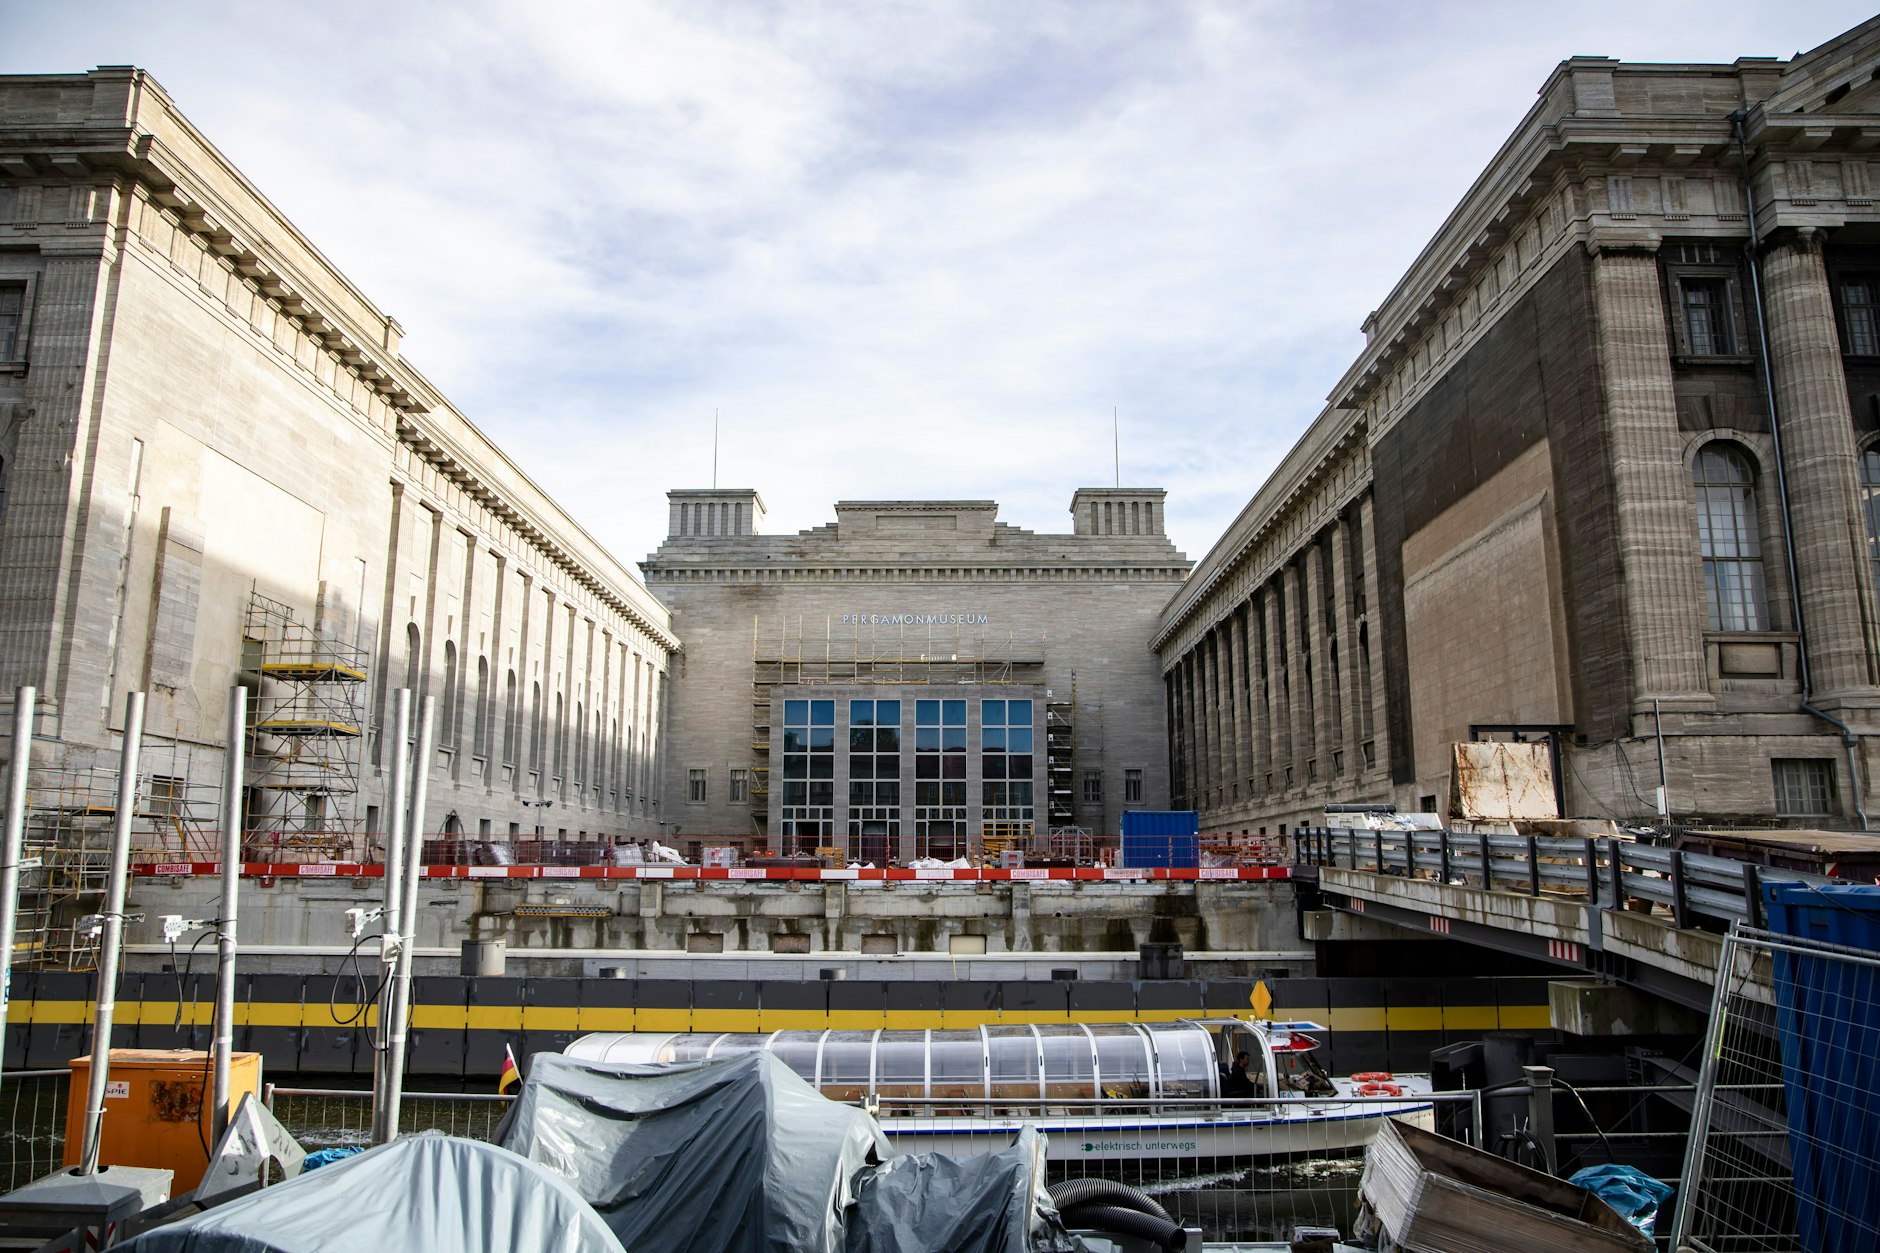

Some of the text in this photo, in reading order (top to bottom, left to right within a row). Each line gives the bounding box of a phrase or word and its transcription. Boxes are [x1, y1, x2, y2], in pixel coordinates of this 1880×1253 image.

[842, 614, 988, 625] PERGAMONMUSEUM
[157, 864, 190, 873] COMBISAFE
[301, 865, 334, 874] COMBISAFE
[544, 867, 577, 876] COMBISAFE
[730, 869, 764, 878] COMBISAFE
[1012, 869, 1046, 878] COMBISAFE
[1106, 869, 1140, 878] COMBISAFE
[1200, 869, 1235, 878] COMBISAFE
[1095, 1141, 1196, 1152] elektrisch unterwegs
